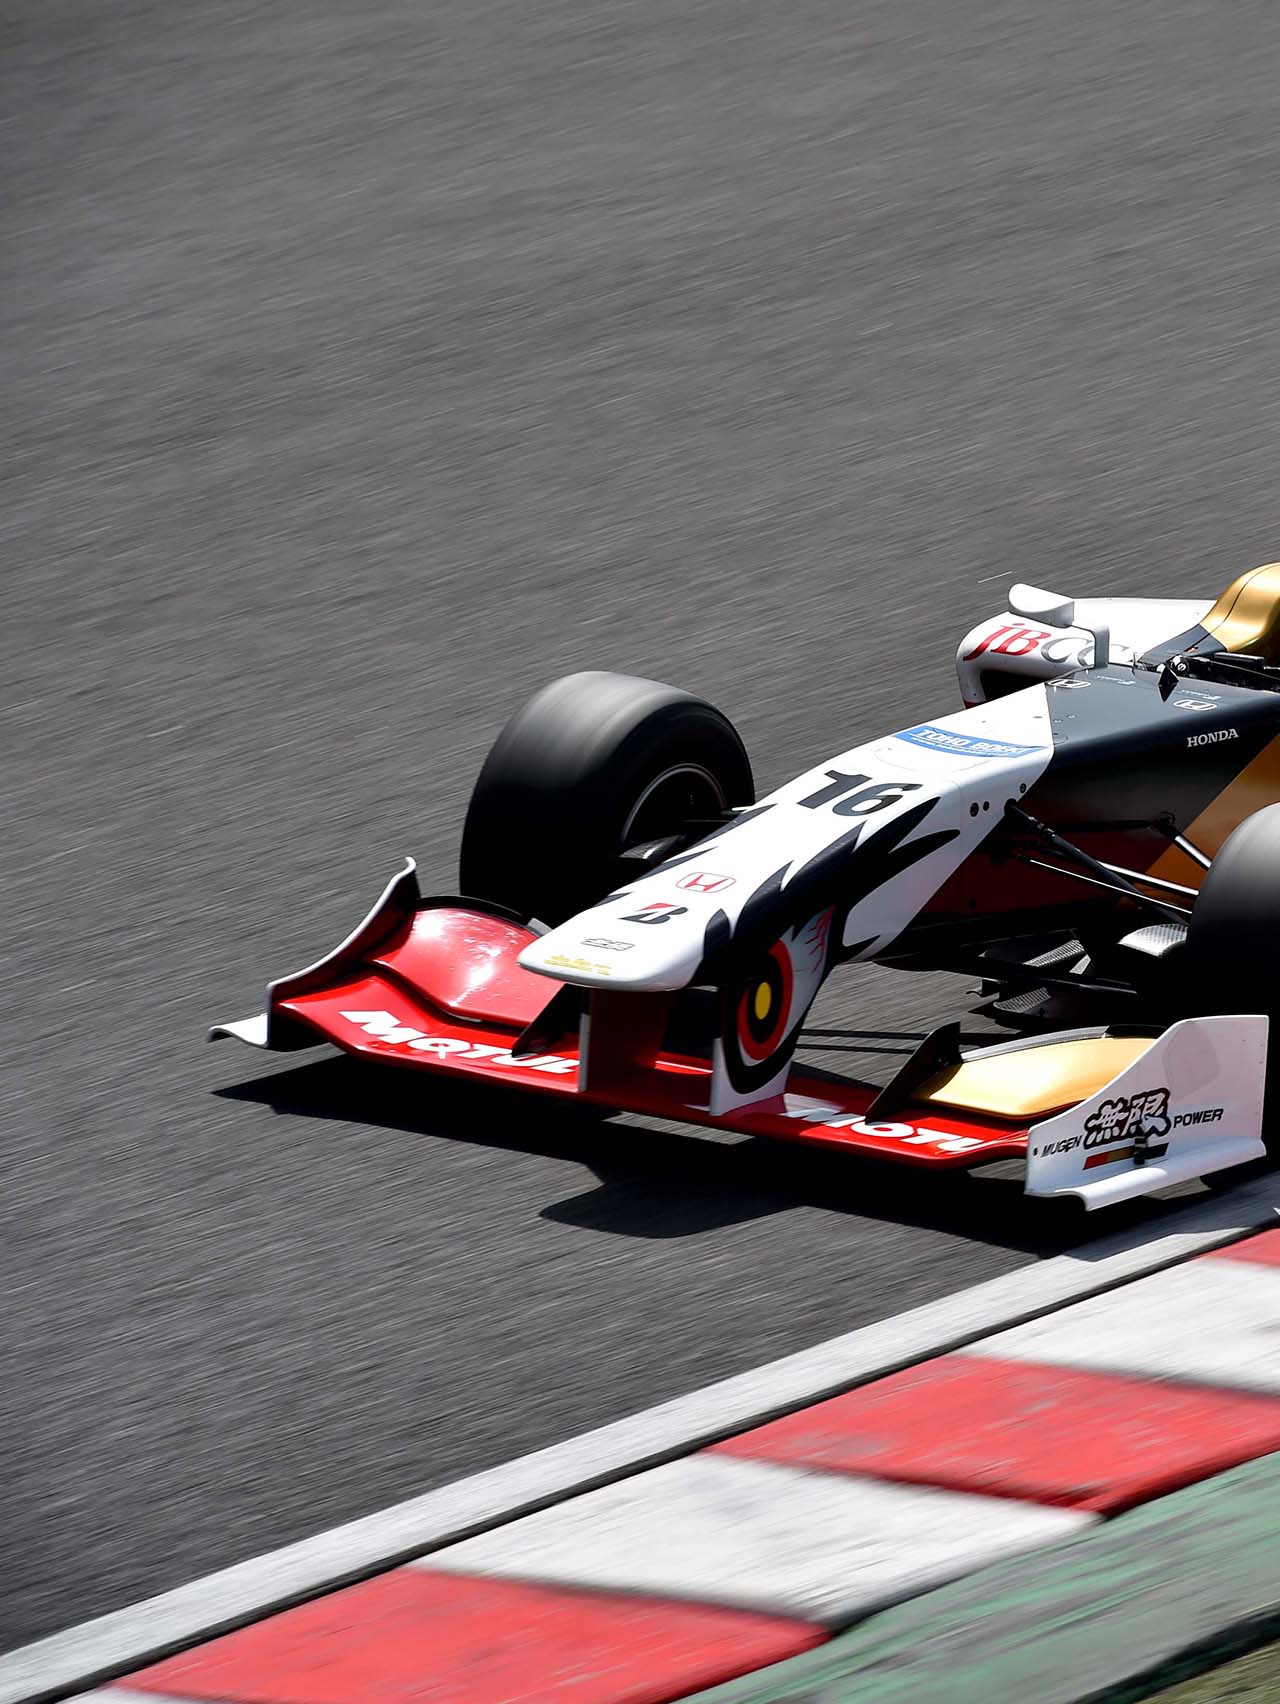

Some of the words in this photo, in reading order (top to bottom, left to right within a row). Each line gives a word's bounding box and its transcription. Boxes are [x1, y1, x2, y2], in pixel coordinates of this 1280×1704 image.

[917, 729, 971, 746] TOHO
[1187, 728, 1239, 748] HONDA
[796, 769, 924, 817] 16
[337, 1010, 580, 1074] MOTUL
[1173, 1108, 1224, 1128] POWER
[1040, 1135, 1083, 1157] MUGEN
